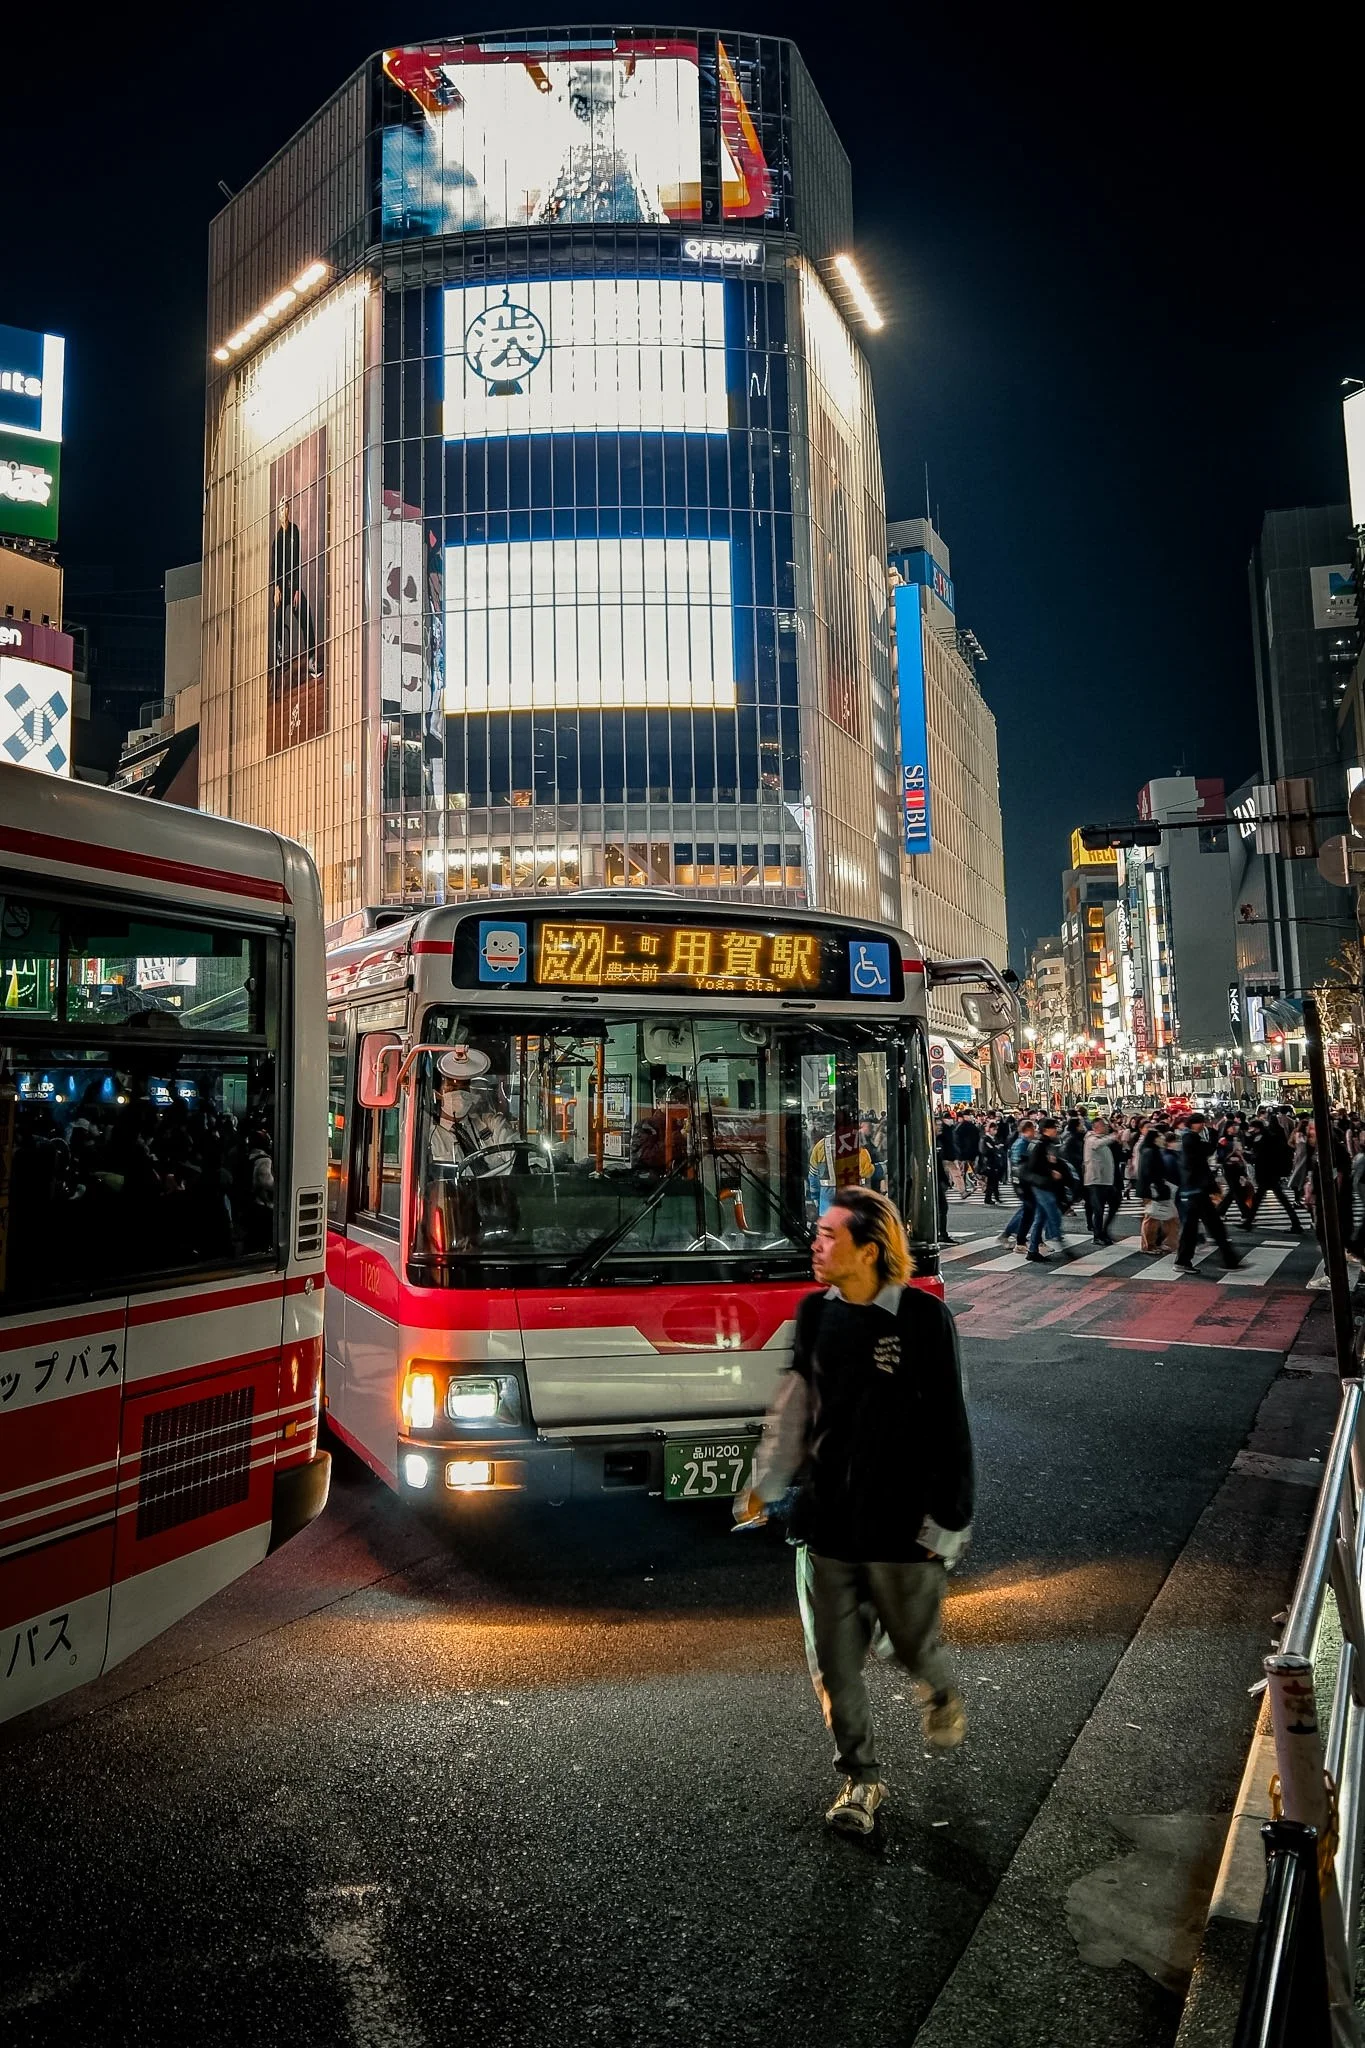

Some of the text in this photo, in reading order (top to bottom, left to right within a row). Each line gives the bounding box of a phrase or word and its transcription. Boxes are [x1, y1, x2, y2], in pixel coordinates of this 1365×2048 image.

[685, 241, 758, 264] QFRONT
[904, 764, 927, 840] SEIBU
[1116, 899, 1129, 952] KARAOKE
[667, 931, 812, 980] 用賀駅
[696, 977, 781, 993] Yoga Sta.
[1229, 988, 1241, 1022] ZARA
